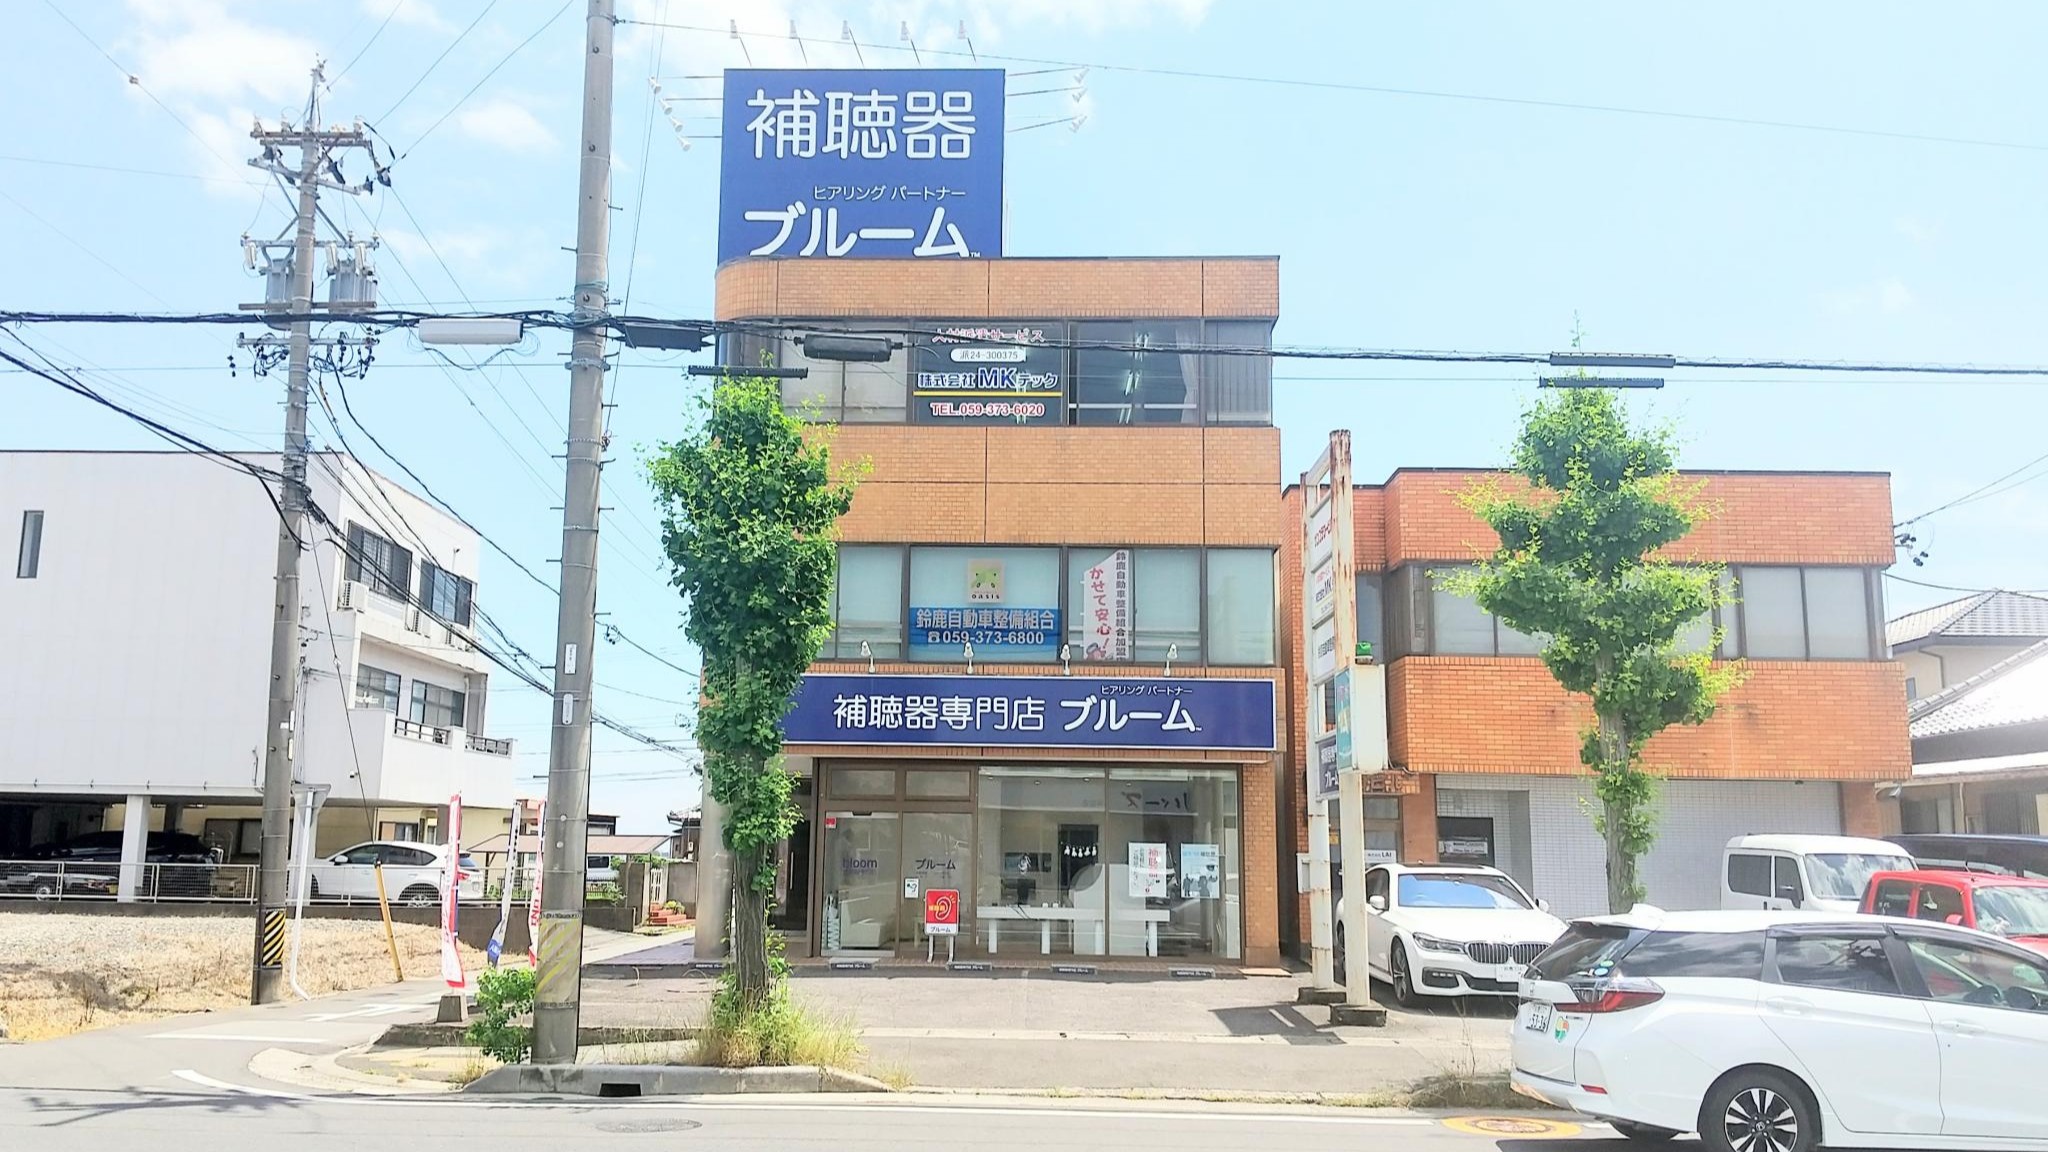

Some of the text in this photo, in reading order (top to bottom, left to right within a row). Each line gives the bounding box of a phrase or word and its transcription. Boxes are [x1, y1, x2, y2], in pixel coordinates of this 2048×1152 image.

[747, 89, 976, 159] 補聴器
[813, 186, 966, 201] ヒアリング パートナー
[744, 201, 970, 258] ブルーム
[930, 402, 1045, 417] TEL.059-373-6020
[916, 608, 1054, 630] 鈴鹿自動車整備組合
[942, 630, 1044, 644] 059-373-6800
[1101, 685, 1193, 696] ヒアリング パートナー
[833, 694, 1196, 732] 補聴器専門店 ブルーム
[915, 857, 956, 870] ブルーム
